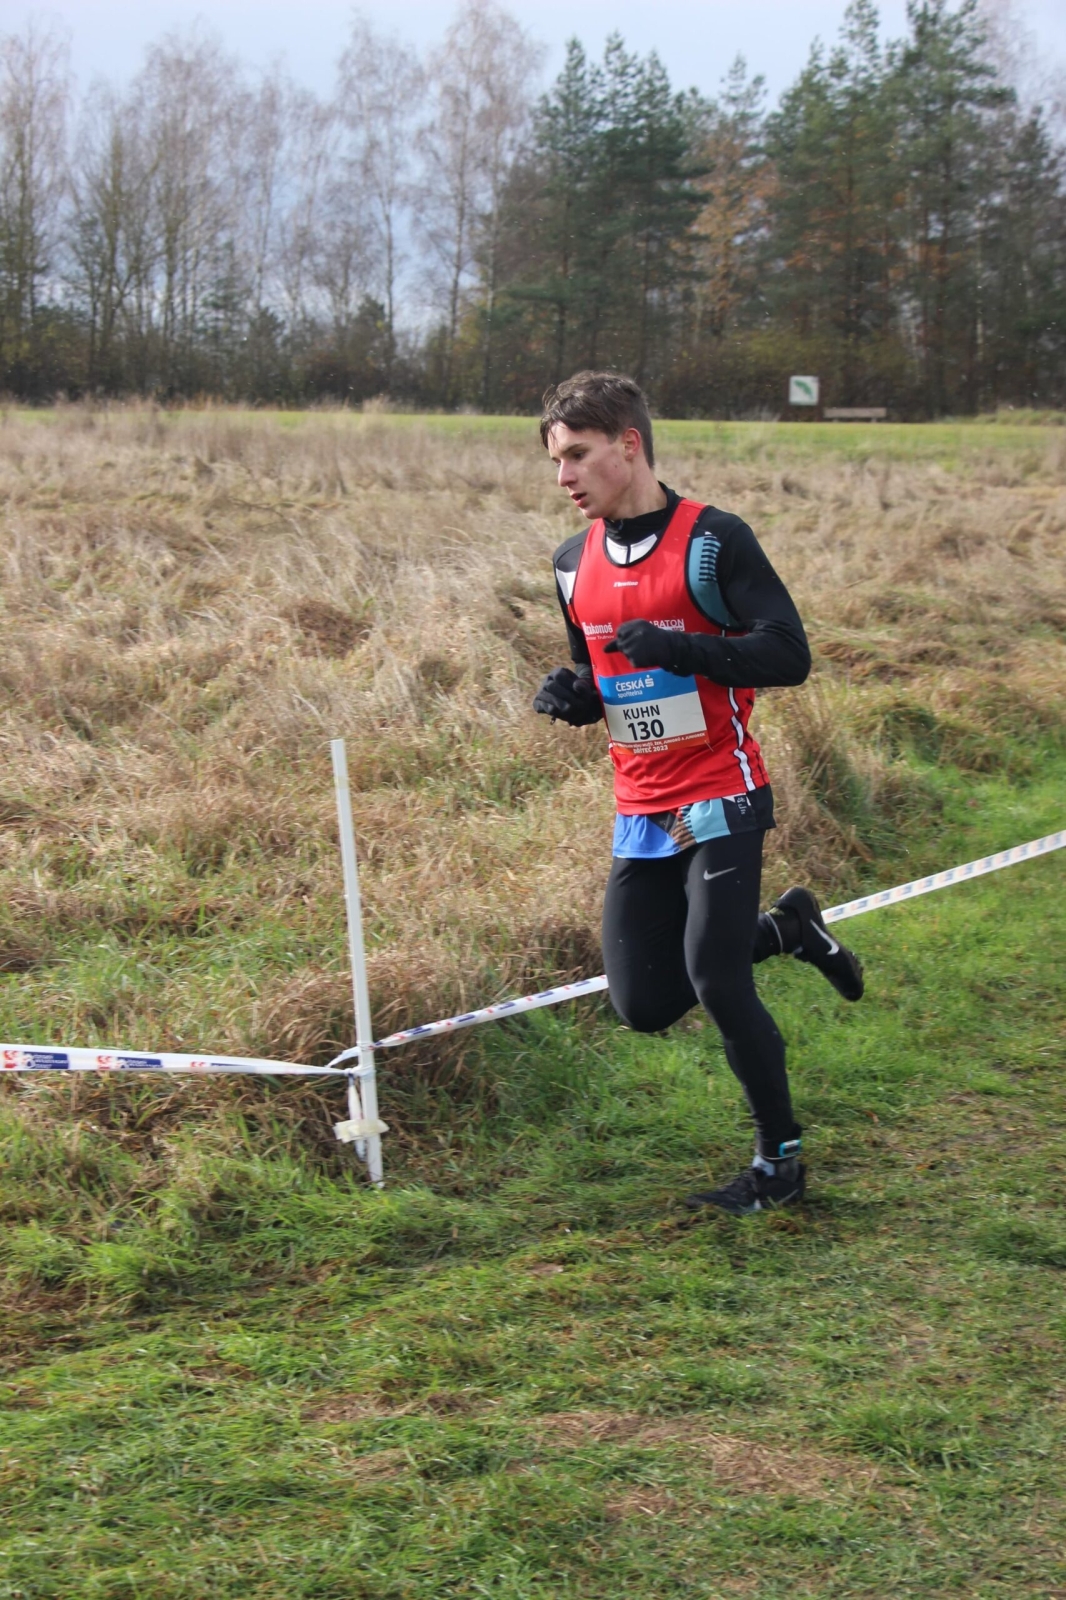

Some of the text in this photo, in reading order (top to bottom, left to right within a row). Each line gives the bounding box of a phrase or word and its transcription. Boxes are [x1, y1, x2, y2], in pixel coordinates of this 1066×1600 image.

[615, 677, 645, 692] ČESKÁ
[617, 689, 643, 699] spořitelna
[623, 704, 660, 720] KUHN
[627, 718, 664, 741] 130
[652, 744, 669, 752] 2023
